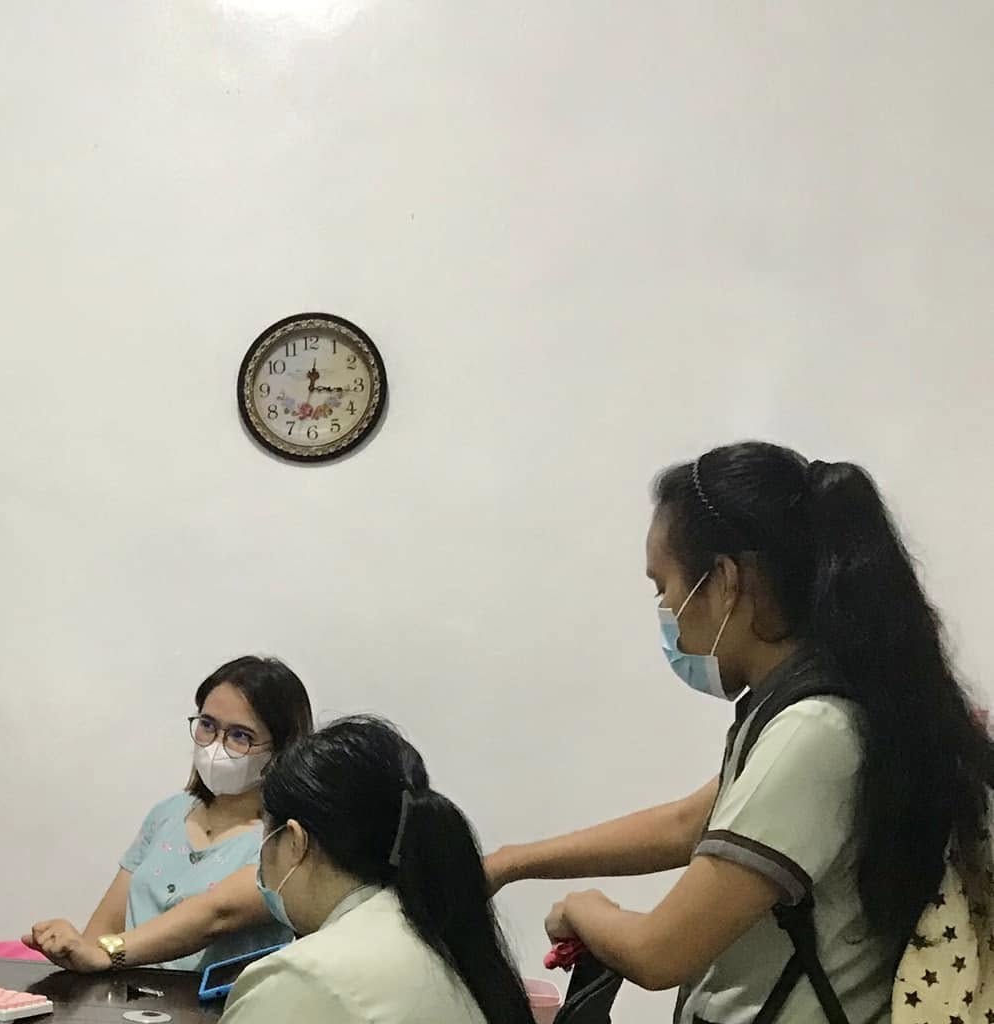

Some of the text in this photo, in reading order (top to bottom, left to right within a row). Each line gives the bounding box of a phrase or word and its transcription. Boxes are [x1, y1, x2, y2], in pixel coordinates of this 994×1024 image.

[286, 342, 296, 357] 11
[303, 336, 319, 351] 12
[269, 360, 286, 375] 10
[347, 355, 357, 370] 2
[259, 383, 270, 398] 9
[353, 378, 365, 392] 3
[268, 404, 278, 419] 8
[346, 400, 357, 415] 4
[286, 421, 296, 436] 7
[307, 425, 318, 440] 6
[330, 419, 341, 433] 5
